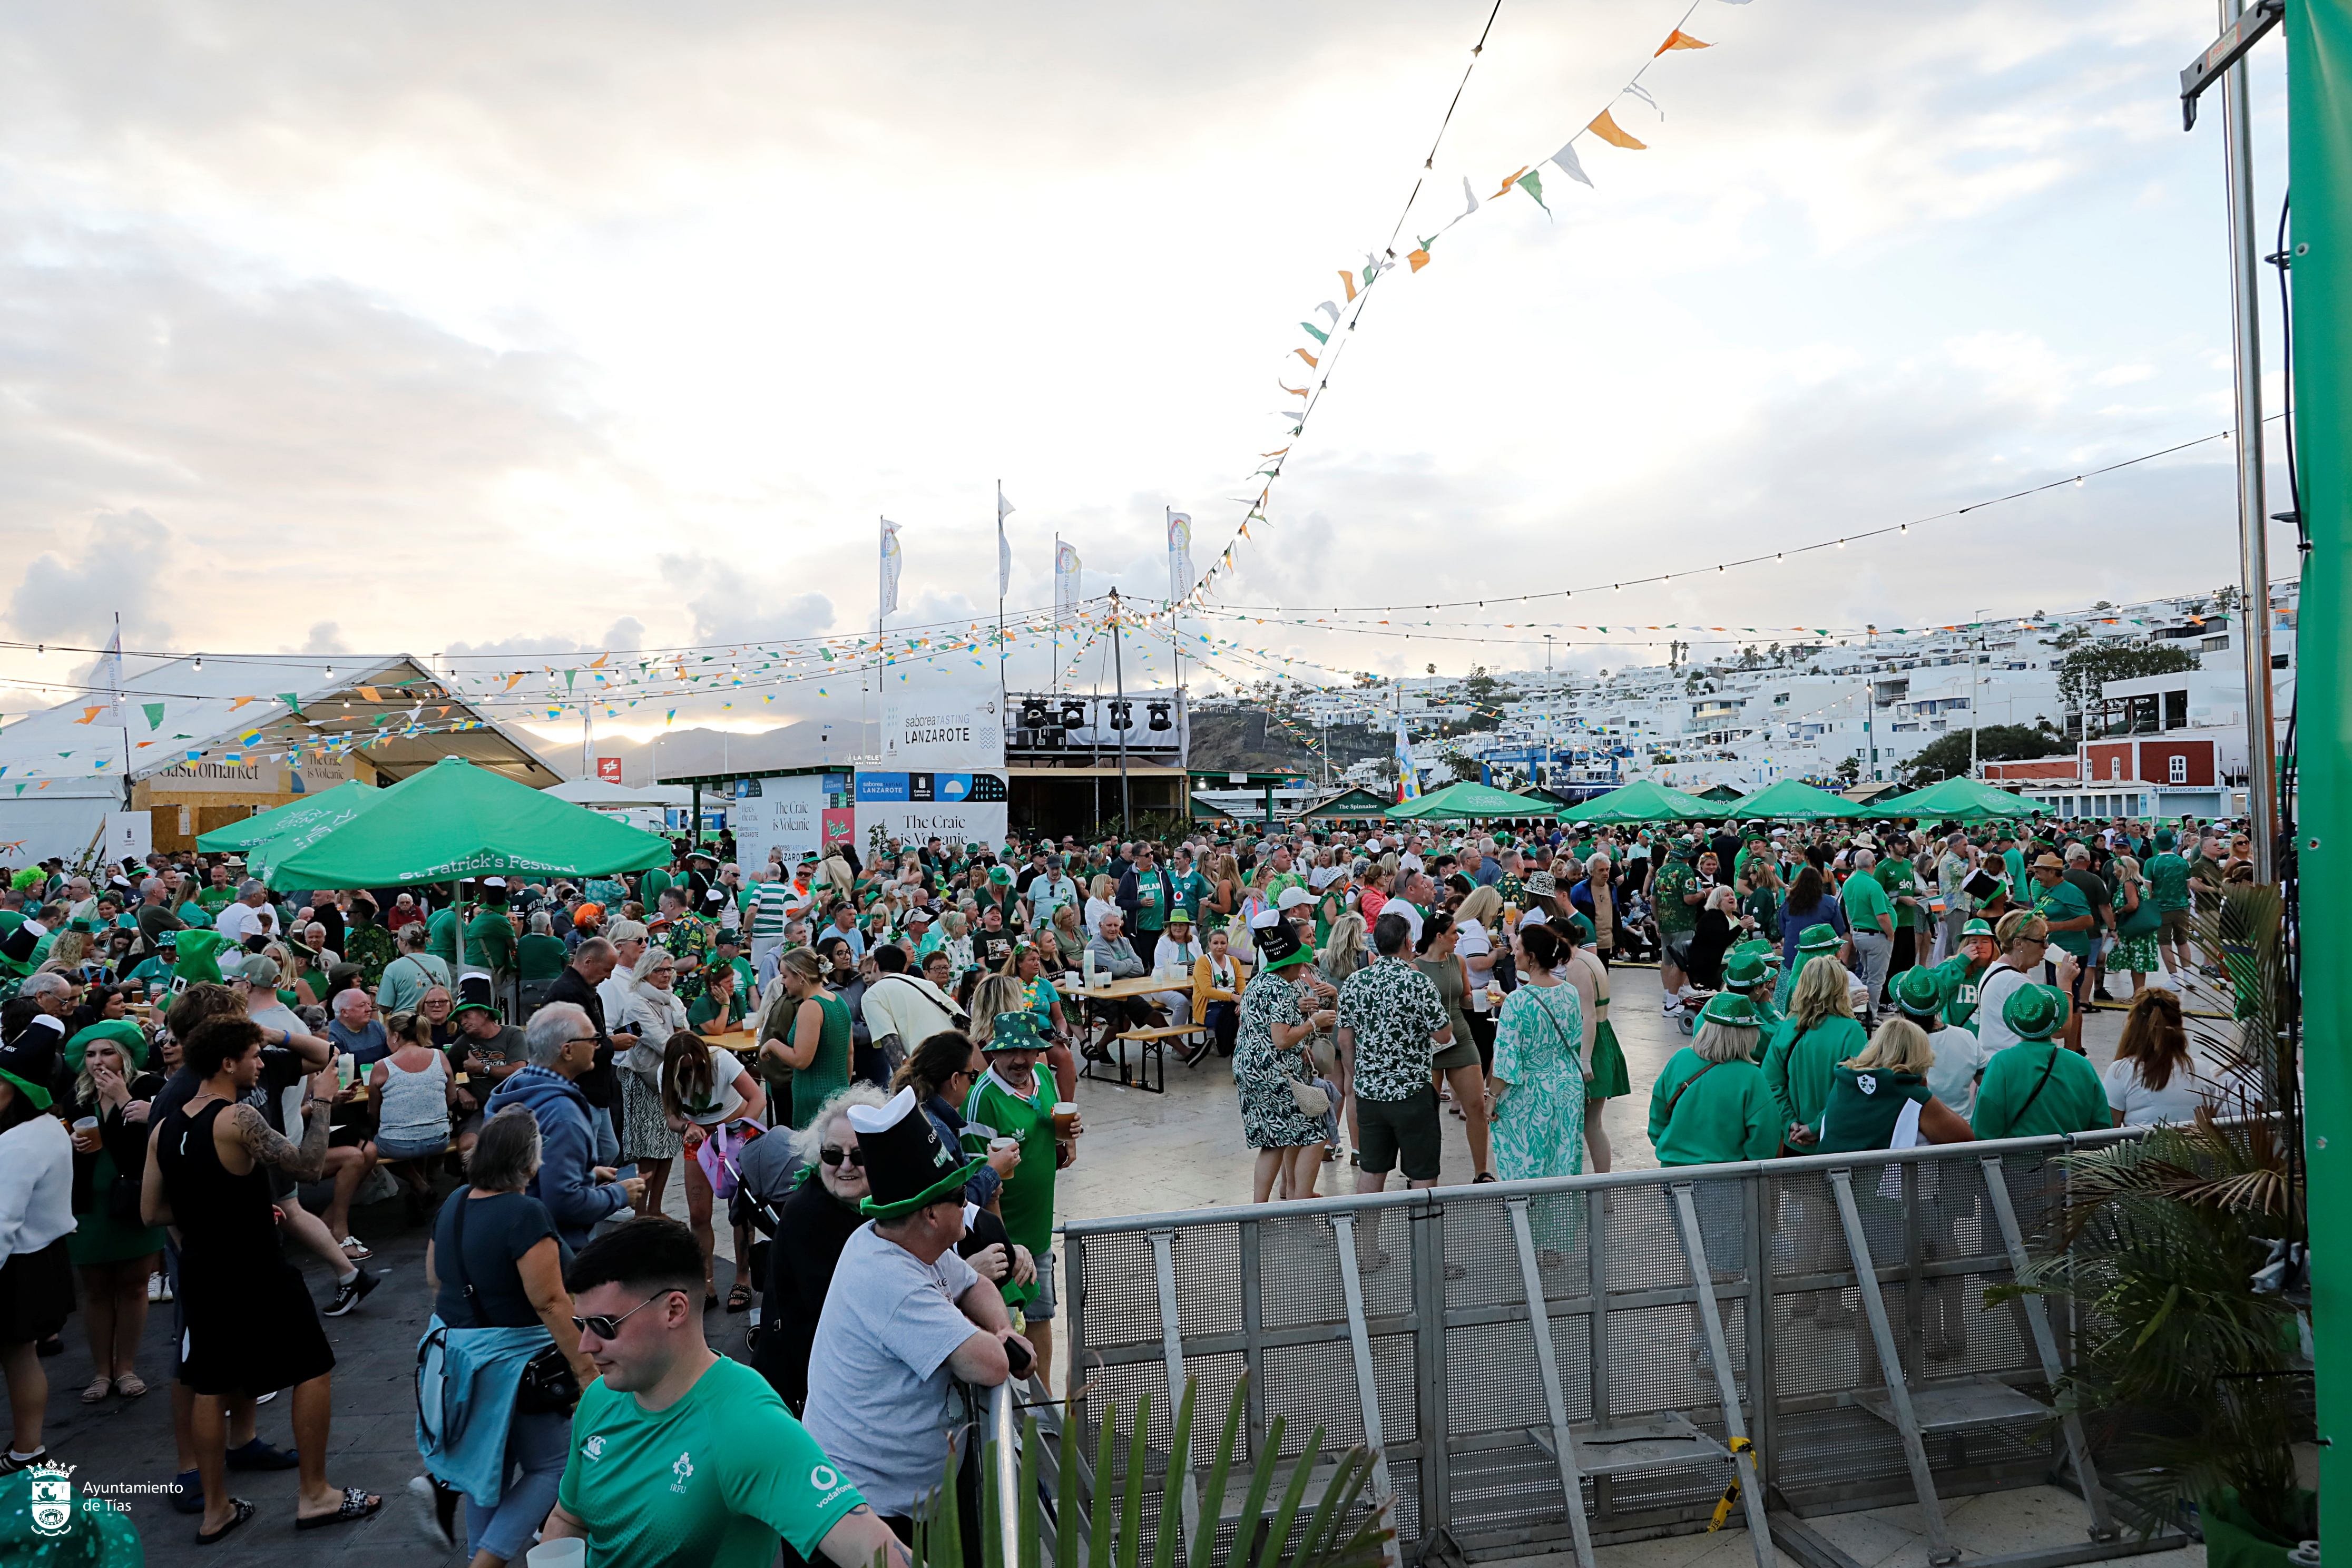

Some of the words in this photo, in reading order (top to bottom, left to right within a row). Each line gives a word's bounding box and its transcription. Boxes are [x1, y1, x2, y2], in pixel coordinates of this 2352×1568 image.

[906, 728, 970, 744] LANZAROTE
[308, 754, 323, 766] The
[308, 768, 315, 778] is
[316, 768, 344, 780] Volcanic
[775, 801, 788, 815] The
[790, 801, 809, 814] Craic
[772, 819, 779, 831] is
[780, 818, 810, 831] Volcanic
[903, 815, 928, 829] The
[932, 815, 966, 829] Craic
[900, 832, 910, 846] is
[399, 871, 424, 880] St.
[427, 854, 504, 876] Patrick's
[507, 854, 577, 873] Festival
[1899, 879, 1913, 890] sky
[1265, 937, 1283, 946] GUINNESS
[1269, 942, 1288, 953] PATRICK'S
[670, 1483, 687, 1494] IRFU
[816, 1483, 854, 1508] vodafone
